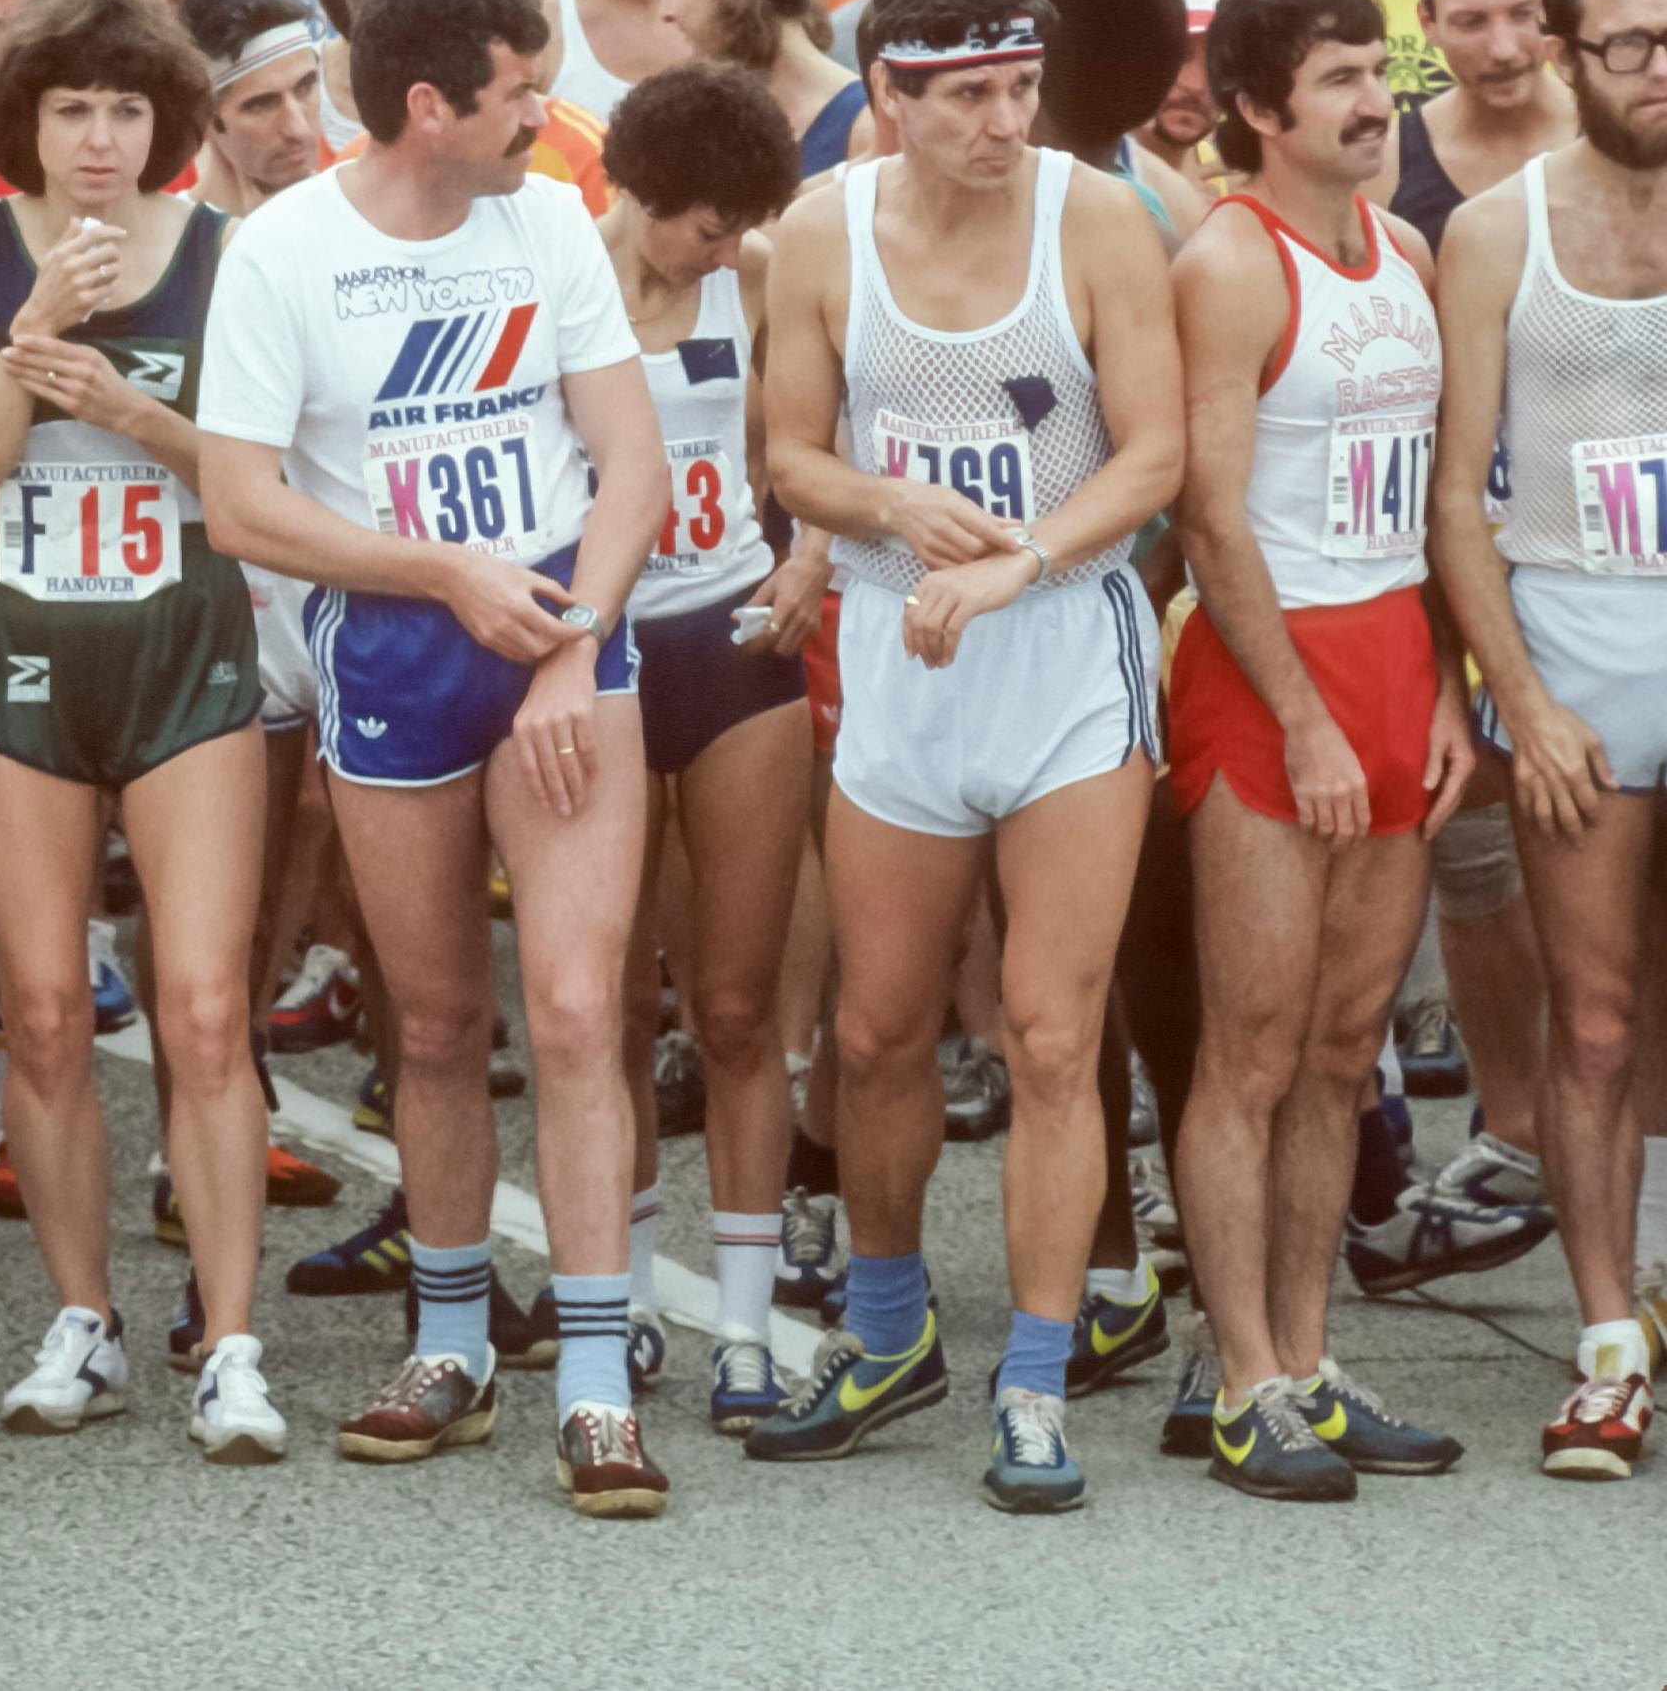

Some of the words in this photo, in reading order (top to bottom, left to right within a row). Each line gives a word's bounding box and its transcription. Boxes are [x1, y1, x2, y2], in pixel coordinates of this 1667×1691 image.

[334, 266, 426, 290] MARATHON
[335, 277, 408, 320] NEW
[413, 270, 496, 312] YORK
[1320, 295, 1436, 374] MARIN
[1337, 364, 1439, 417] RACERS
[368, 406, 426, 430] AIR
[368, 417, 529, 458] MANUFACTURERS
[879, 410, 1023, 443] MANUFACTURERS
[80, 484, 164, 577] 15
[46, 577, 135, 593] HANOVER
